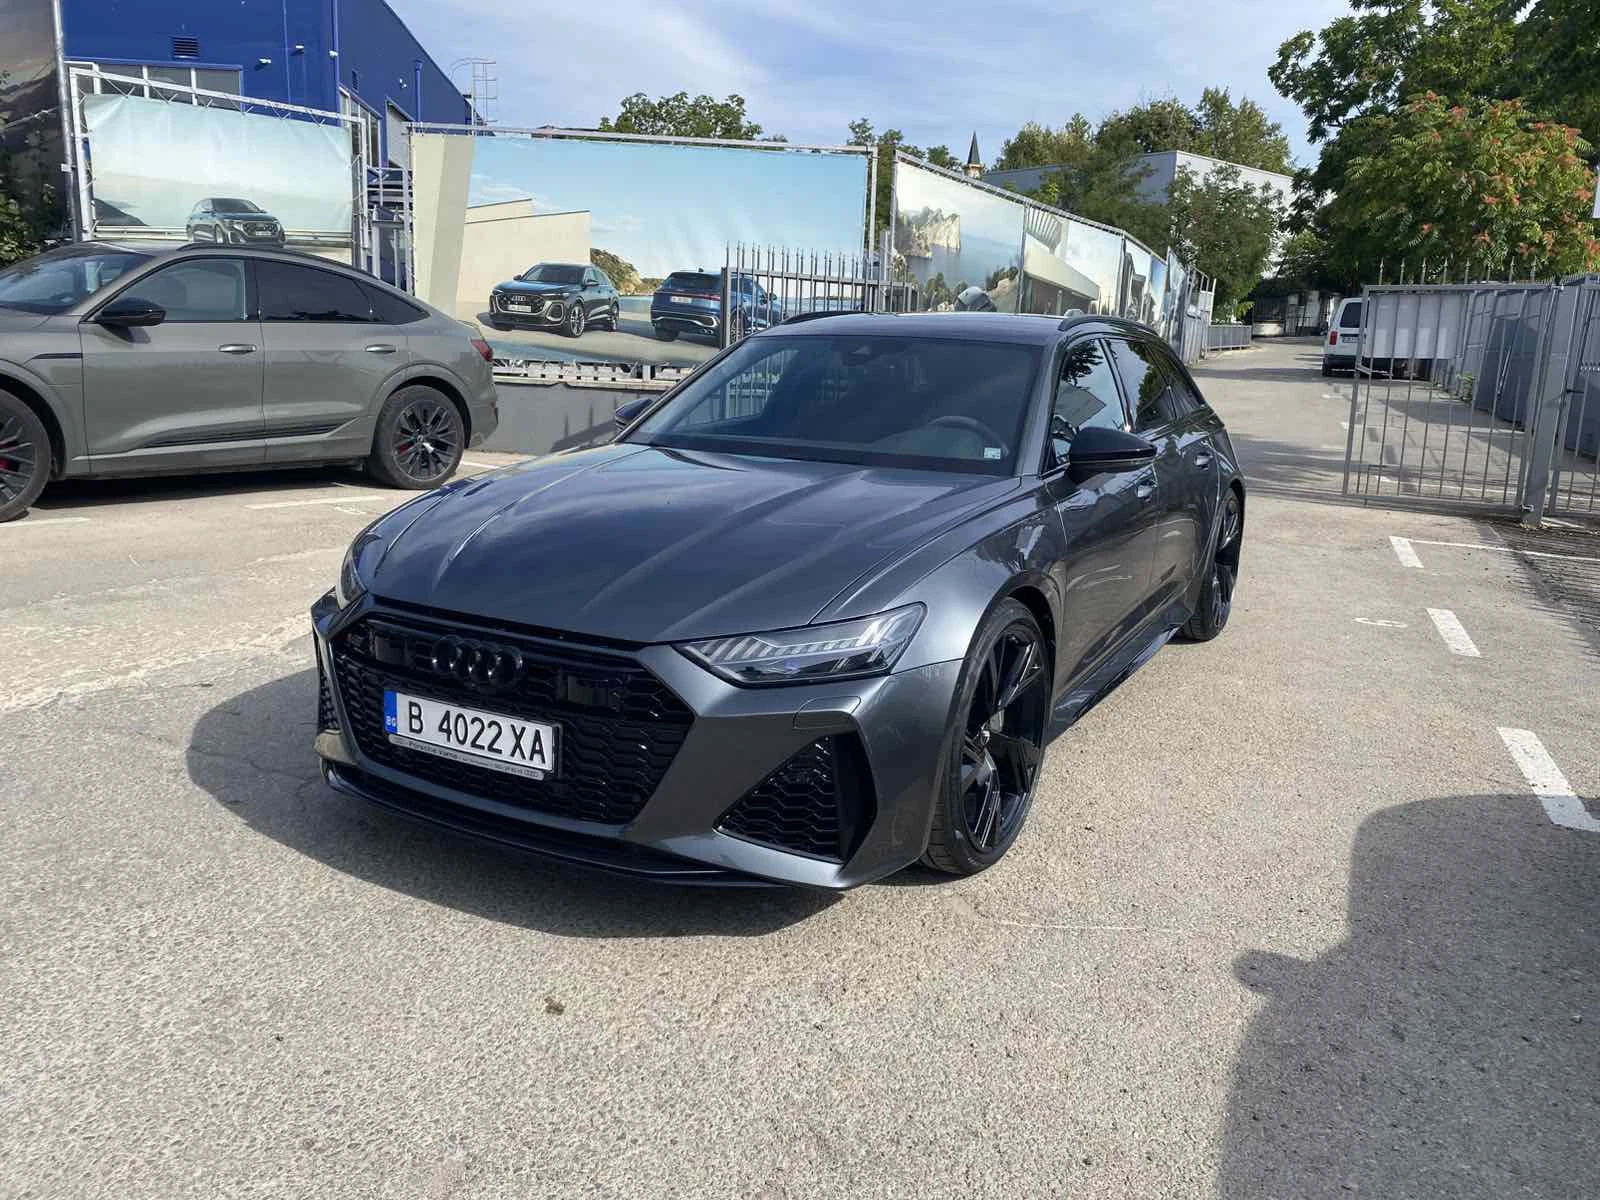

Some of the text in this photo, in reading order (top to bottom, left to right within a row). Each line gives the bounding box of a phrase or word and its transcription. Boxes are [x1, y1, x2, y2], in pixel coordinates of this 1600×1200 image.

[385, 715, 397, 728] BG
[408, 701, 547, 765] B 4022 XA
